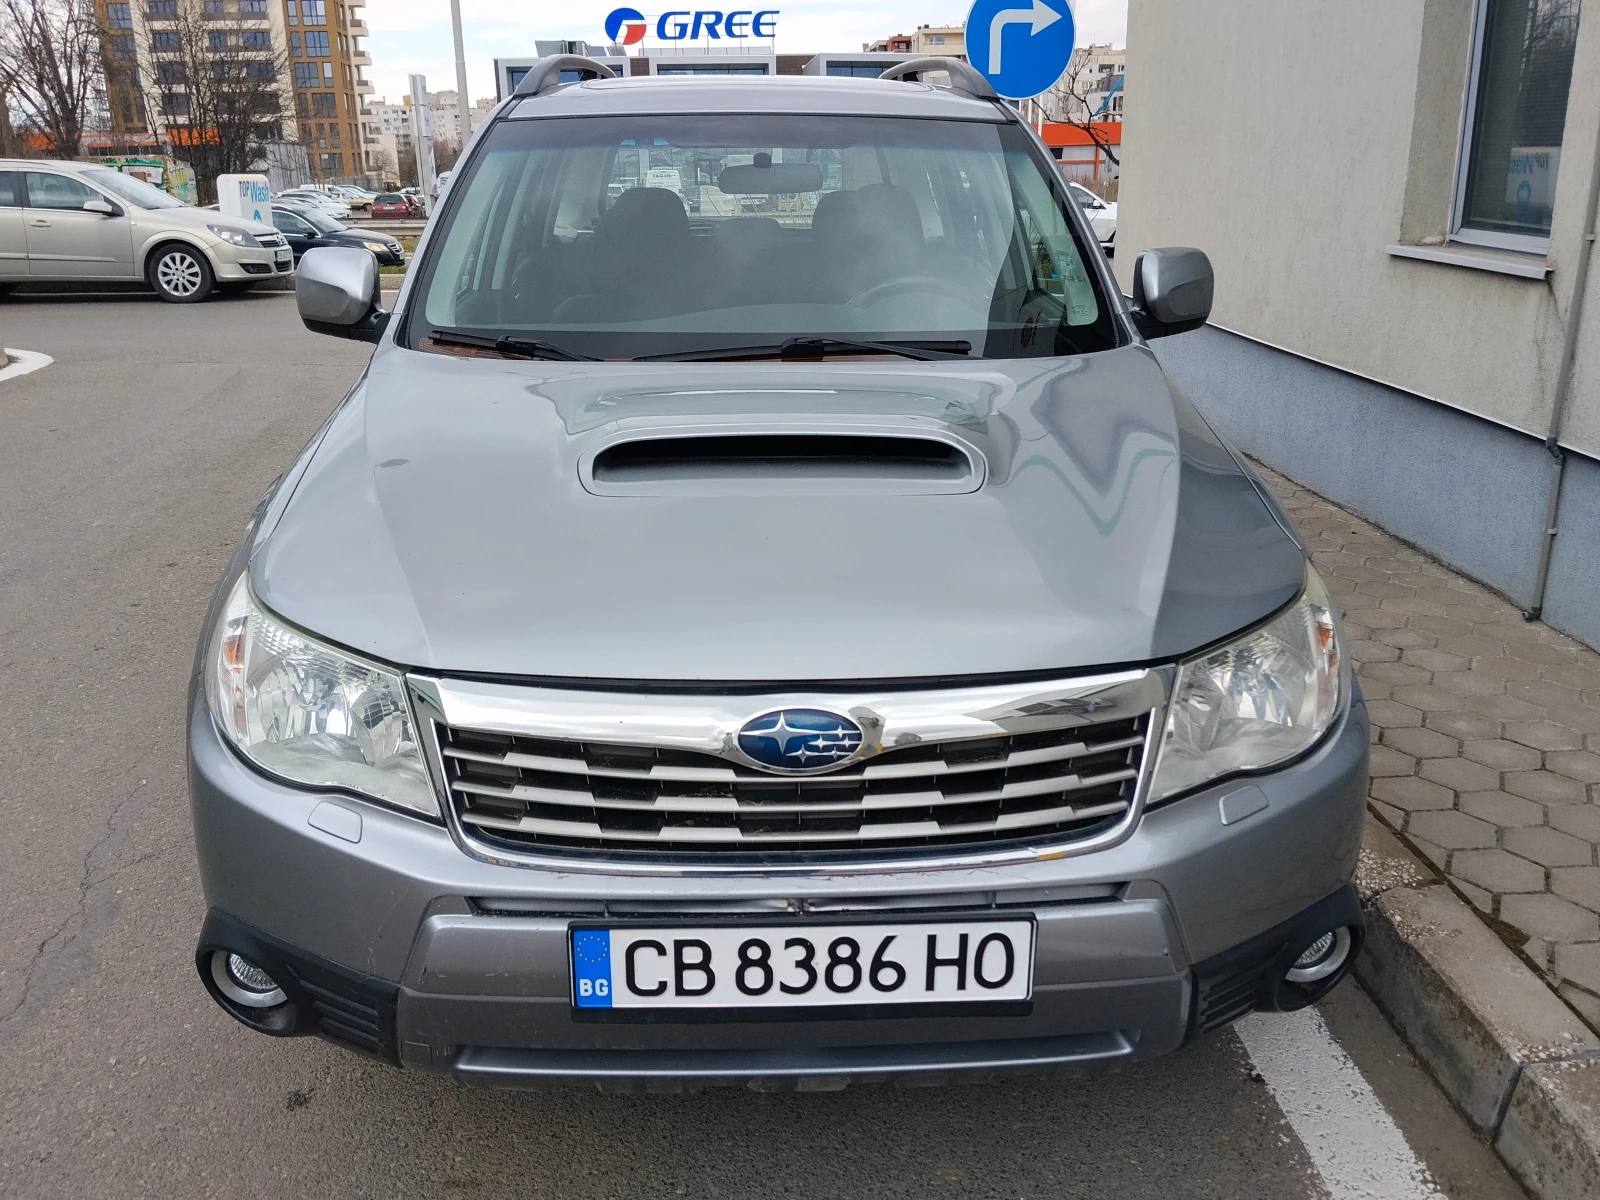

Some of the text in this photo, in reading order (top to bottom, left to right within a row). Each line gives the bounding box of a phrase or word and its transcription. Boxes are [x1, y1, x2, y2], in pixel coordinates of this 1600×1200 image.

[656, 10, 781, 41] GREE
[239, 181, 269, 203] TOP Wash
[624, 931, 1015, 997] CB 8386 HO
[579, 978, 609, 997] BG
